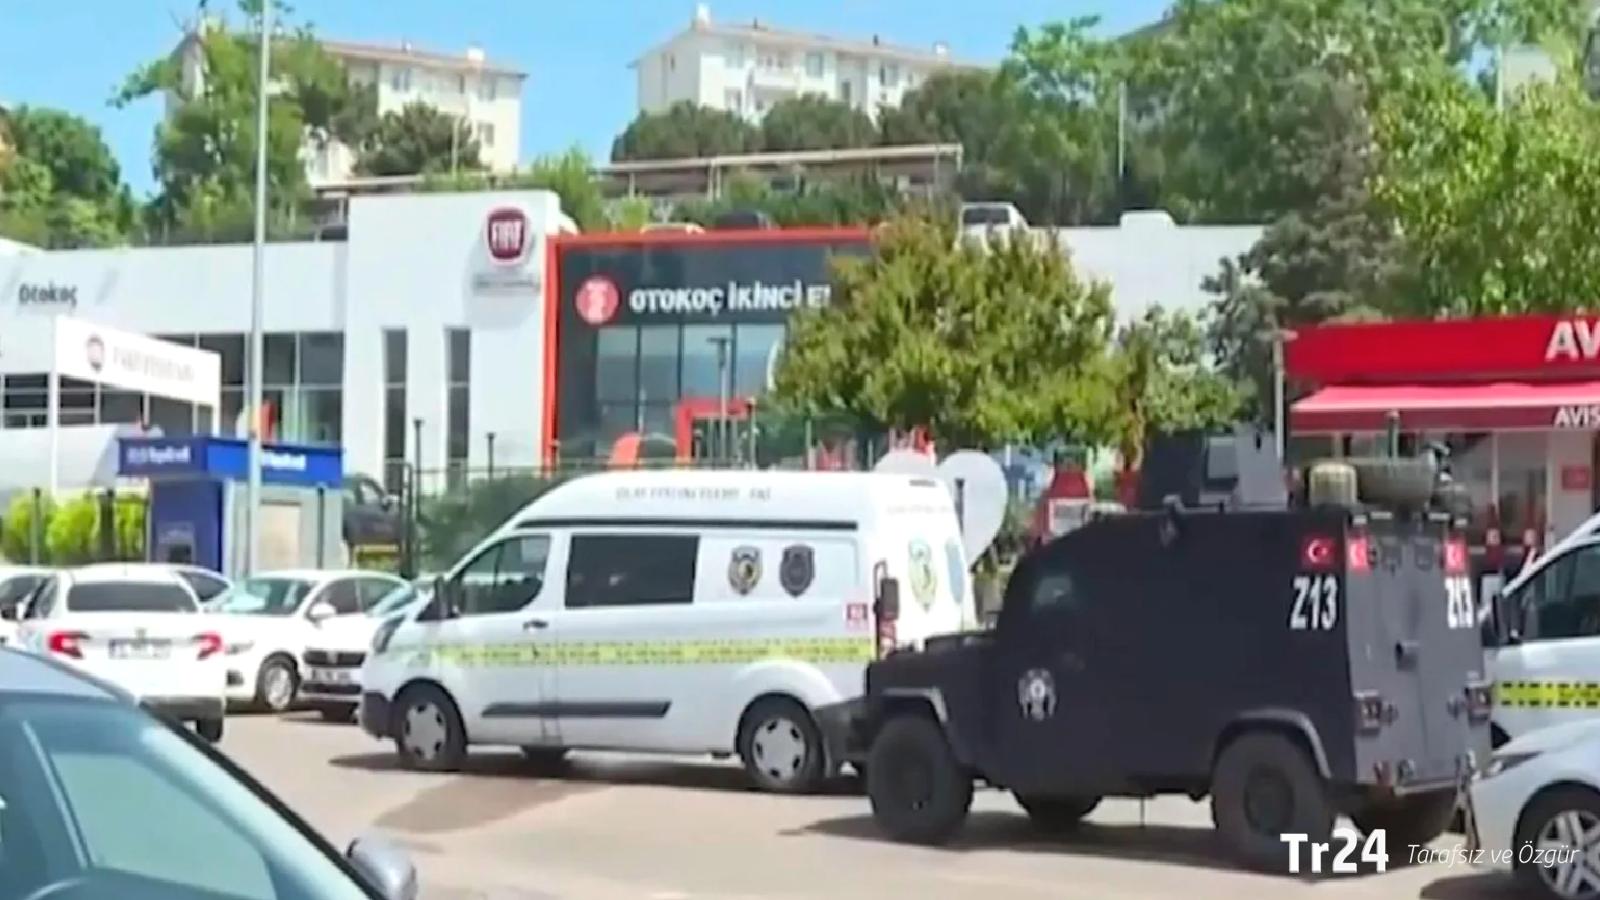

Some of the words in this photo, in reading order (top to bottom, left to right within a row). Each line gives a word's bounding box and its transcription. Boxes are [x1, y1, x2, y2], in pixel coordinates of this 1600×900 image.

[18, 279, 78, 308] Otokoç
[629, 287, 724, 316] OTOKOÇ
[728, 280, 802, 311] İKİNCİ
